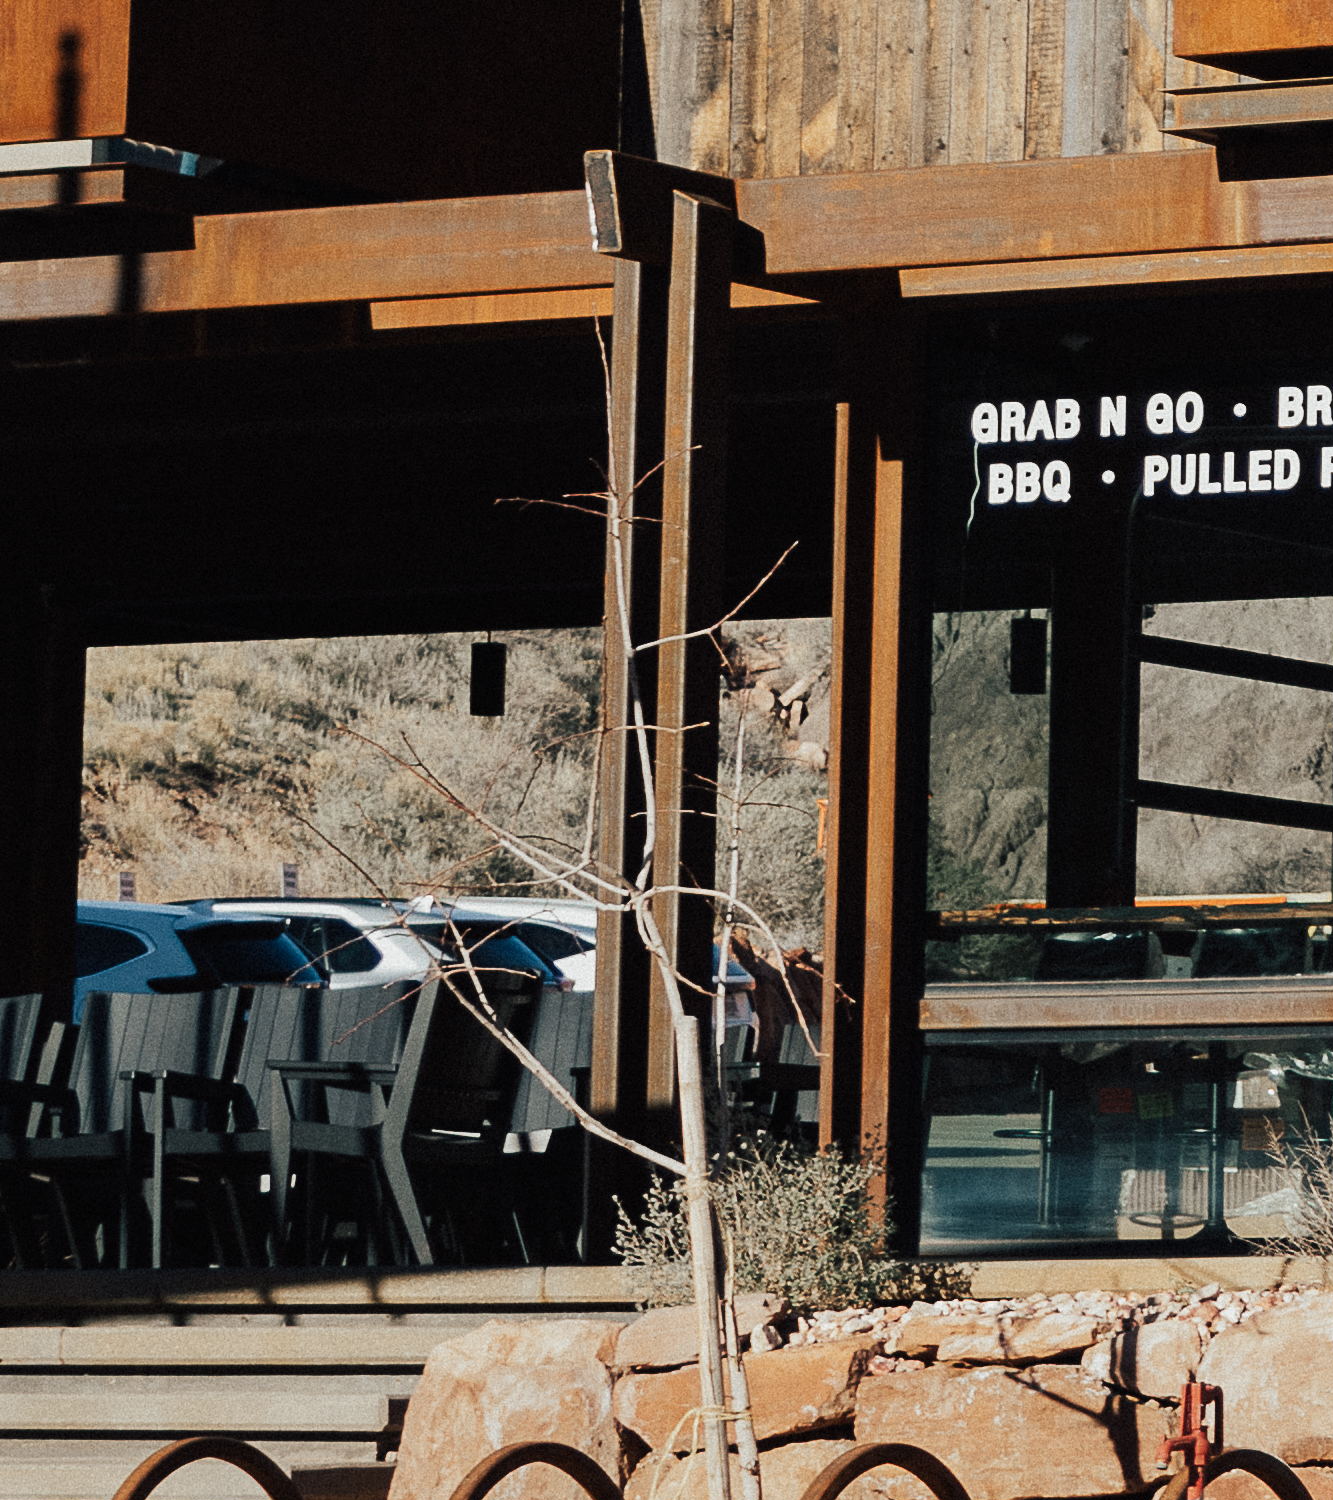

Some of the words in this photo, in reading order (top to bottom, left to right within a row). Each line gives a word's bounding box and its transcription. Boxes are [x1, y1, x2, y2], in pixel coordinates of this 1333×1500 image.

[971, 399, 1081, 443] GRAB
[1099, 395, 1127, 438] N
[1146, 391, 1204, 434] GO
[988, 461, 1071, 505] BBQ
[1143, 449, 1300, 497] PULLED
